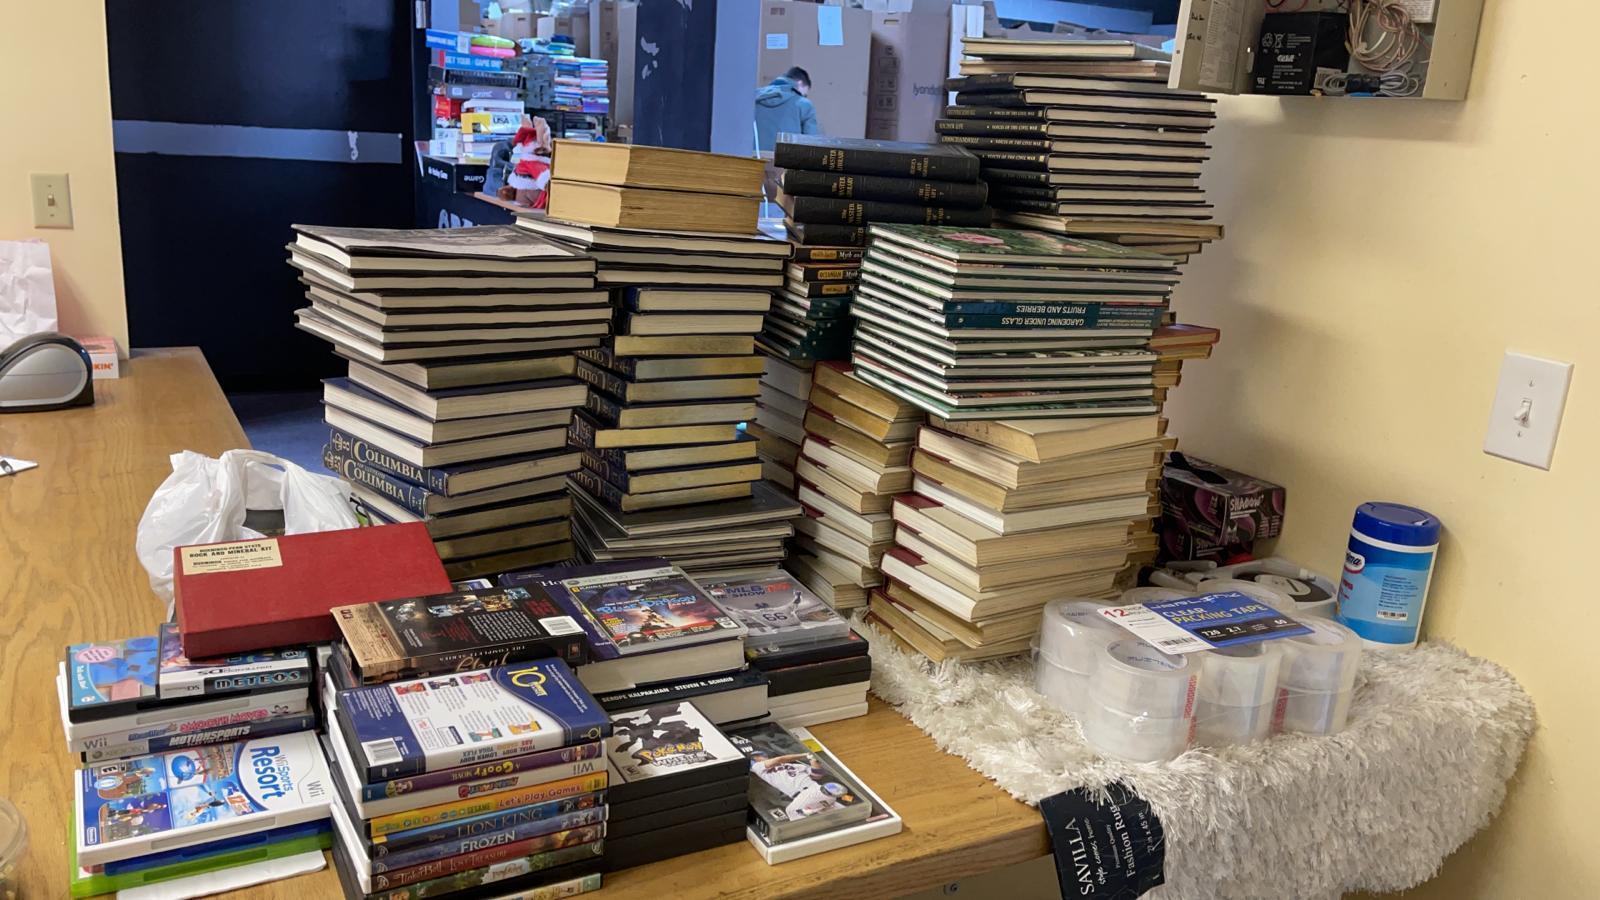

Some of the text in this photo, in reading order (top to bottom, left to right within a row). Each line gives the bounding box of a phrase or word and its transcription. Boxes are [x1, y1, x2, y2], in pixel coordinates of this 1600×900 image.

[464, 175, 484, 184] Game
[1016, 305, 1046, 313] BERRIES
[1063, 306, 1086, 314] FRUITS
[1024, 317, 1046, 325] UNDER
[354, 440, 424, 484] COLUMBIA
[344, 459, 405, 502] COLUMBIA
[726, 584, 764, 594] MLB
[732, 590, 766, 598] SHOW
[762, 612, 788, 622] 66
[1104, 608, 1128, 618] 12
[1162, 608, 1204, 618] CLEAR
[1171, 604, 1268, 624] PACKING TAPE
[214, 670, 301, 690] METEOS
[674, 682, 700, 690] STEVEN
[169, 726, 252, 746] MOTIONSPORTS
[84, 737, 108, 750] Wii
[477, 752, 497, 760] LOWER
[250, 746, 286, 800] Resort
[572, 762, 594, 776] Wii
[307, 780, 325, 798] Wii
[500, 796, 521, 807] Let's
[525, 791, 545, 802] Play
[548, 786, 582, 797] Games
[457, 818, 496, 838] LION
[502, 808, 542, 827] KING
[1141, 820, 1148, 830] 45
[460, 830, 516, 854] FROZEN
[1109, 804, 1136, 878] Fashion Rug
[1064, 817, 1095, 896] SAVILLA
[1084, 817, 1108, 885] style comes home
